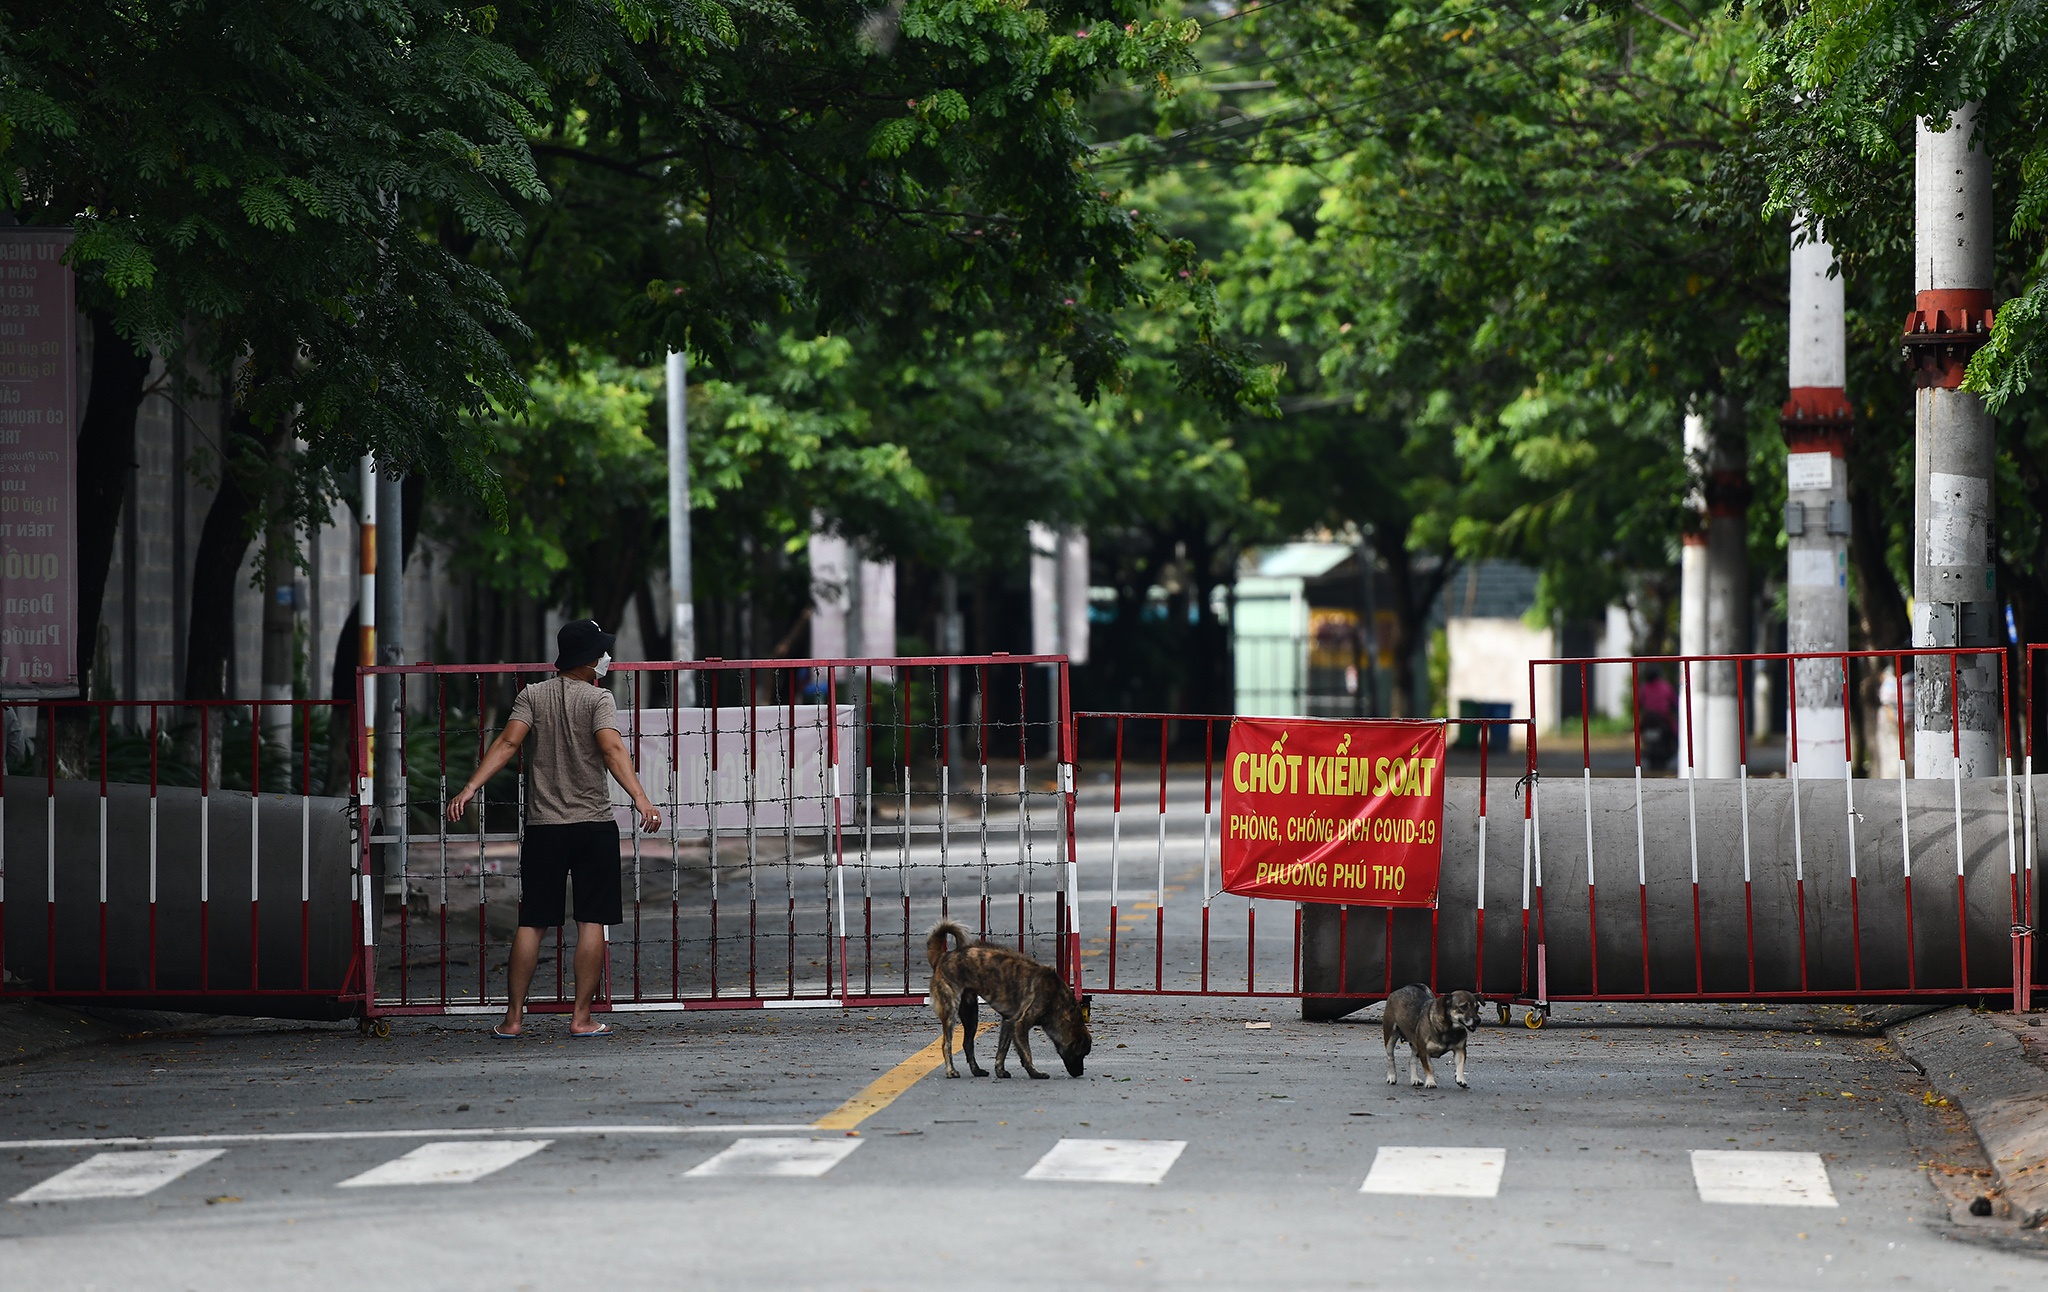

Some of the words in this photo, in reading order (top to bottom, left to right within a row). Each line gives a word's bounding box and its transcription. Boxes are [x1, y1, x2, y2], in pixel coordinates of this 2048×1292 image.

[1232, 731, 1302, 794] CHỐT
[1307, 733, 1369, 796] KIỂM
[1372, 743, 1436, 797] SOÁT
[1230, 810, 1282, 846] PHÒNG,
[1287, 809, 1334, 843] CHỐNG
[1338, 817, 1371, 845] DỊCH
[1373, 819, 1436, 845] COVID-19
[1255, 858, 1328, 888] PHƯỜNG
[1332, 859, 1367, 889] PHÚ
[1372, 864, 1406, 895] THỌ
